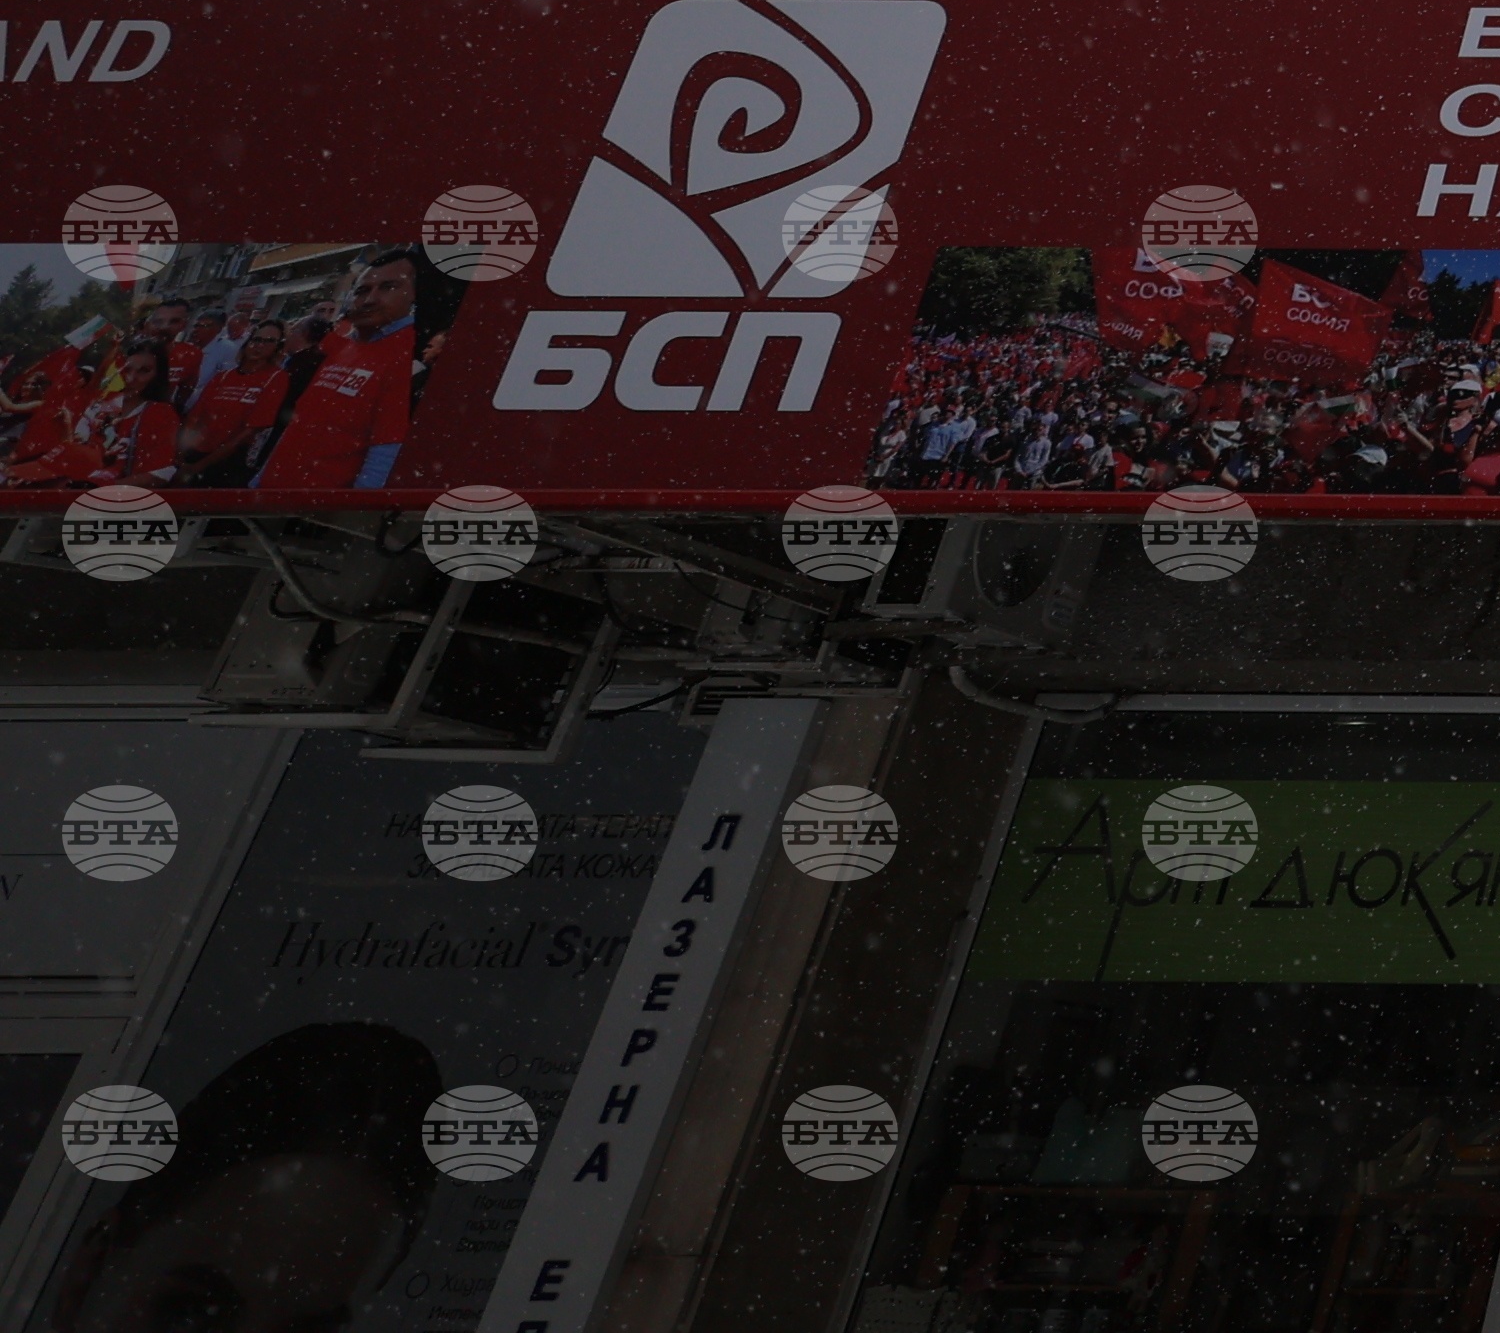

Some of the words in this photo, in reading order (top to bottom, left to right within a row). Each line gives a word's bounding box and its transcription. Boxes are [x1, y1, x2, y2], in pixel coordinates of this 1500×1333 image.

[0, 19, 171, 83] ND
[1125, 280, 1183, 299] СОФ
[1110, 321, 1144, 341] ФИЯ
[1287, 307, 1350, 332] СОФИЯ
[493, 311, 842, 412] БСП
[1264, 348, 1336, 369] СОФИЯ
[344, 374, 367, 390] 28
[573, 815, 743, 1183] ЛАЗЕРНА
